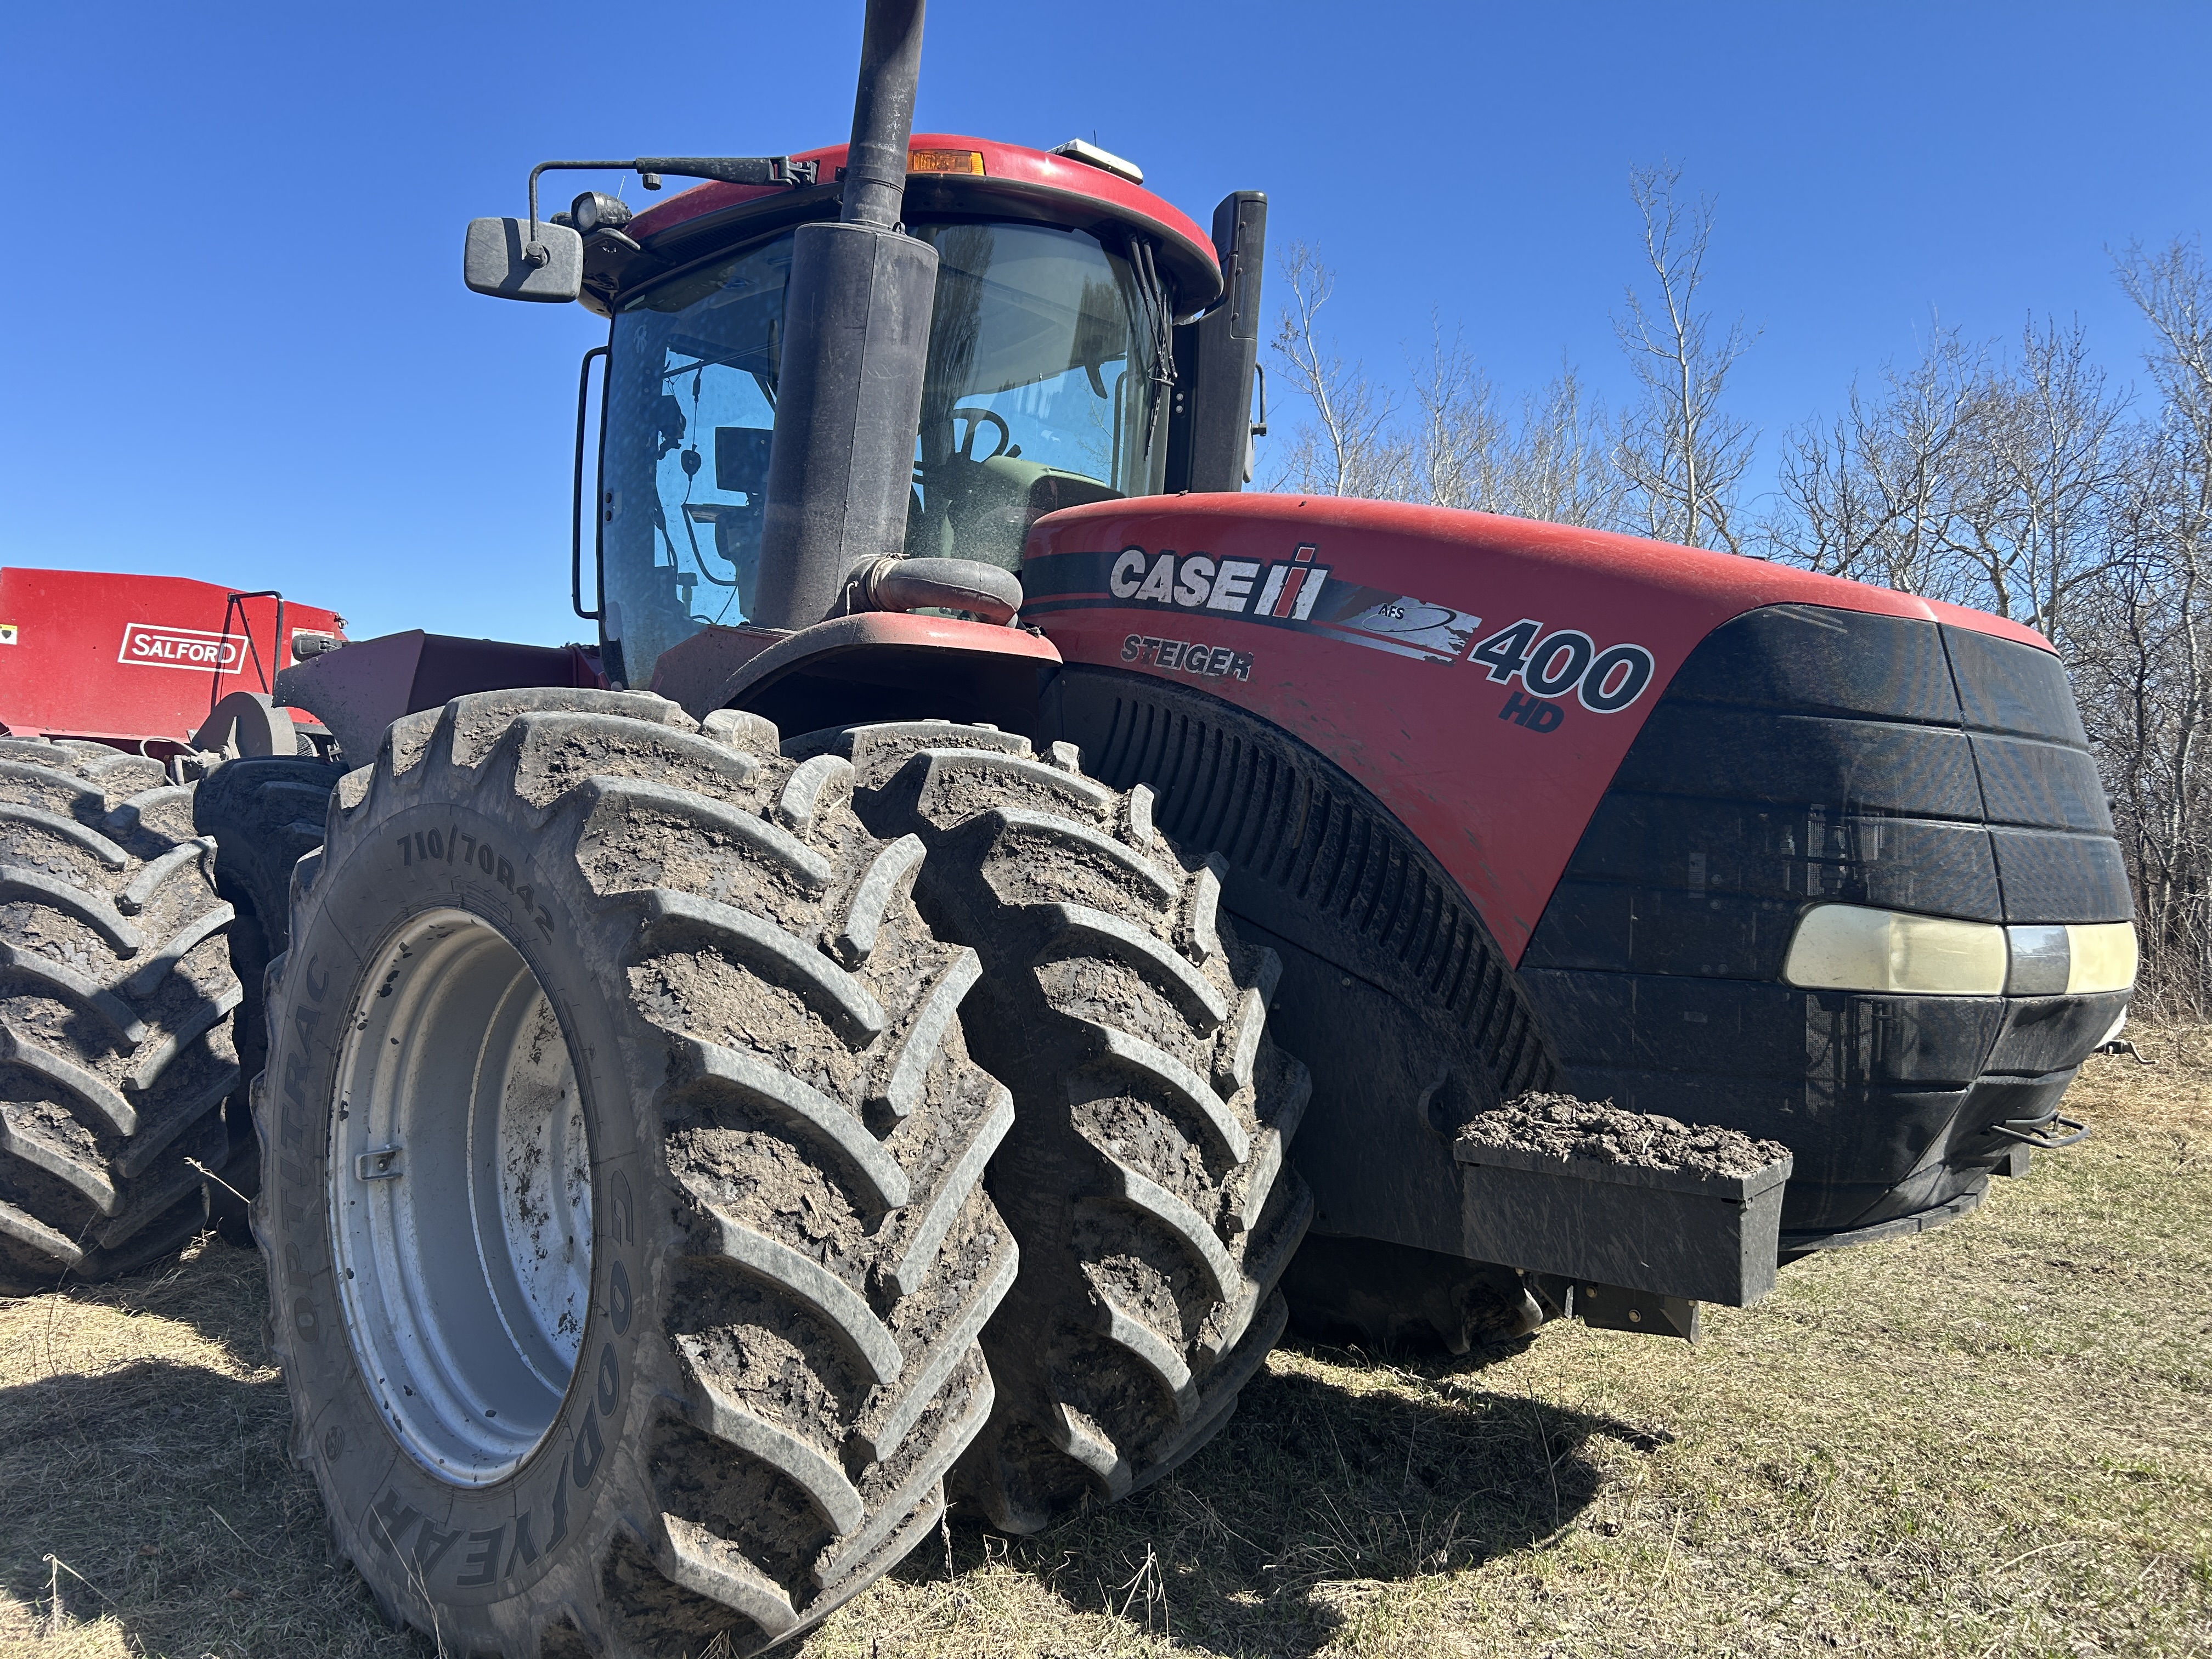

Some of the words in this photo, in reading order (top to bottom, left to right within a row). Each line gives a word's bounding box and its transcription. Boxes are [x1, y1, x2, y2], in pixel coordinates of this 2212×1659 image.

[1110, 550, 1260, 613] CASE
[1378, 604, 1405, 620] AFS
[132, 634, 236, 664] SALFORD
[1120, 634, 1255, 682] STEIGER
[1466, 618, 1655, 714] 400
[1498, 691, 1565, 733] HD
[397, 822, 554, 945] 710/70R42
[280, 952, 329, 1342] OPTITRAC
